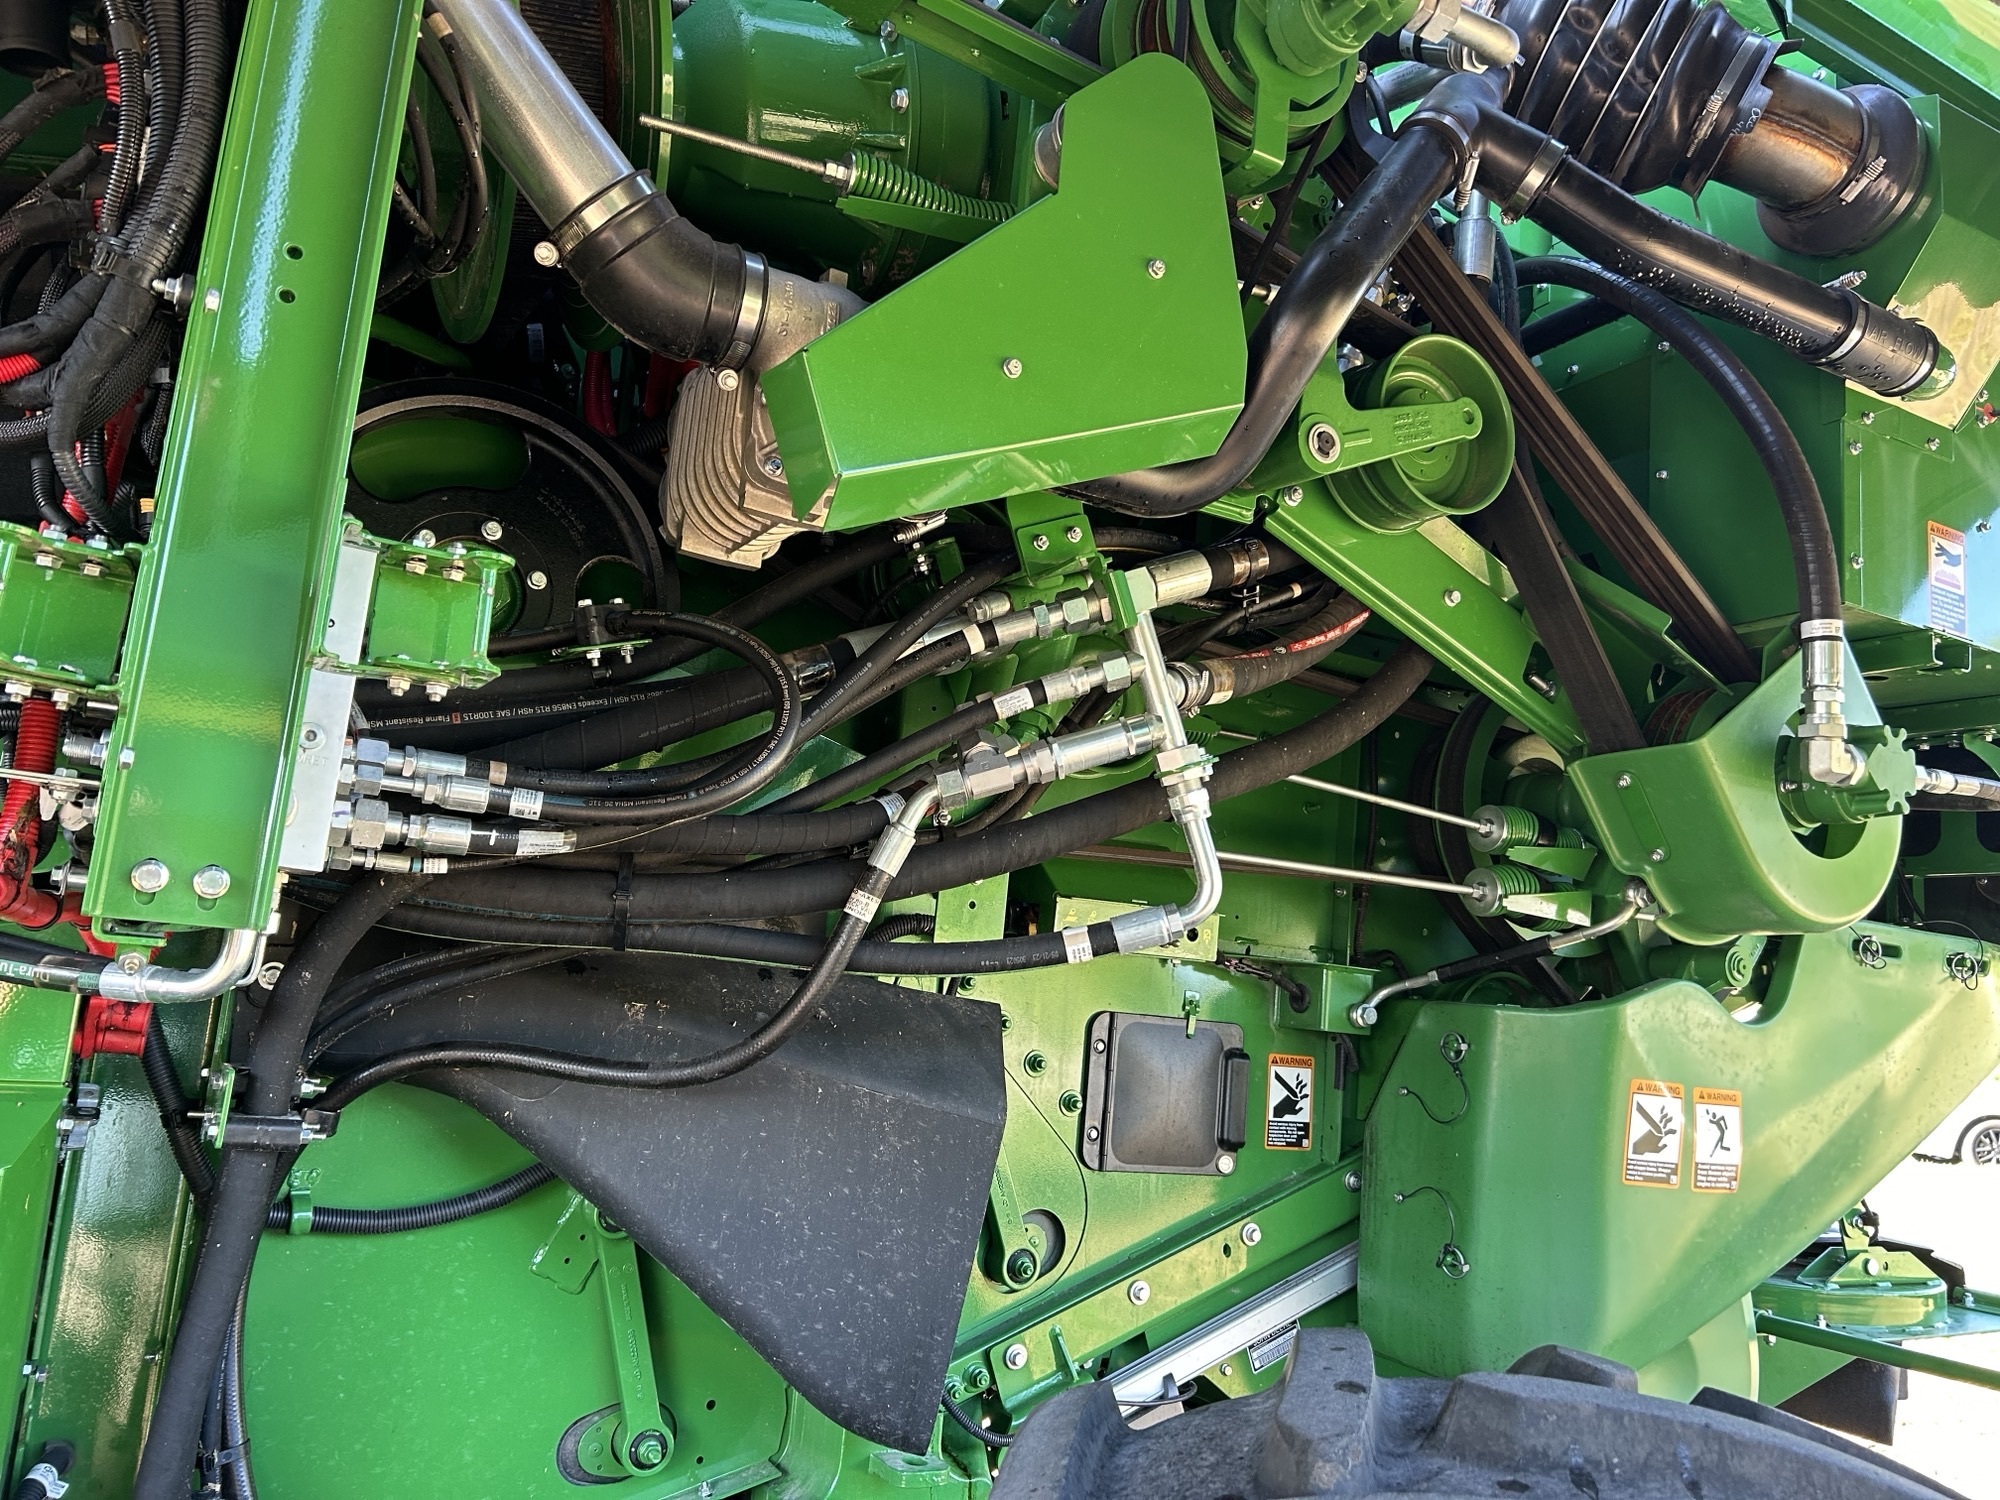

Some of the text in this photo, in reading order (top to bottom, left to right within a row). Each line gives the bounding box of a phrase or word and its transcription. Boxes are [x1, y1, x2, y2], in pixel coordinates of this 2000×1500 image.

[1867, 325, 1888, 344] AIR
[1936, 526, 1963, 543] WARNING
[578, 698, 608, 706] Exceeds
[535, 705, 550, 713] R15
[385, 716, 423, 726] Resistant
[425, 714, 450, 723] Flame
[463, 710, 493, 722] 100R15
[781, 710, 790, 726] 11237
[776, 727, 785, 737] R17
[767, 740, 778, 749] SAE
[752, 749, 770, 767] 100R17
[1279, 1057, 1312, 1066] WARNING
[1645, 1084, 1680, 1095] WARING
[1707, 1093, 1736, 1101] WARNING
